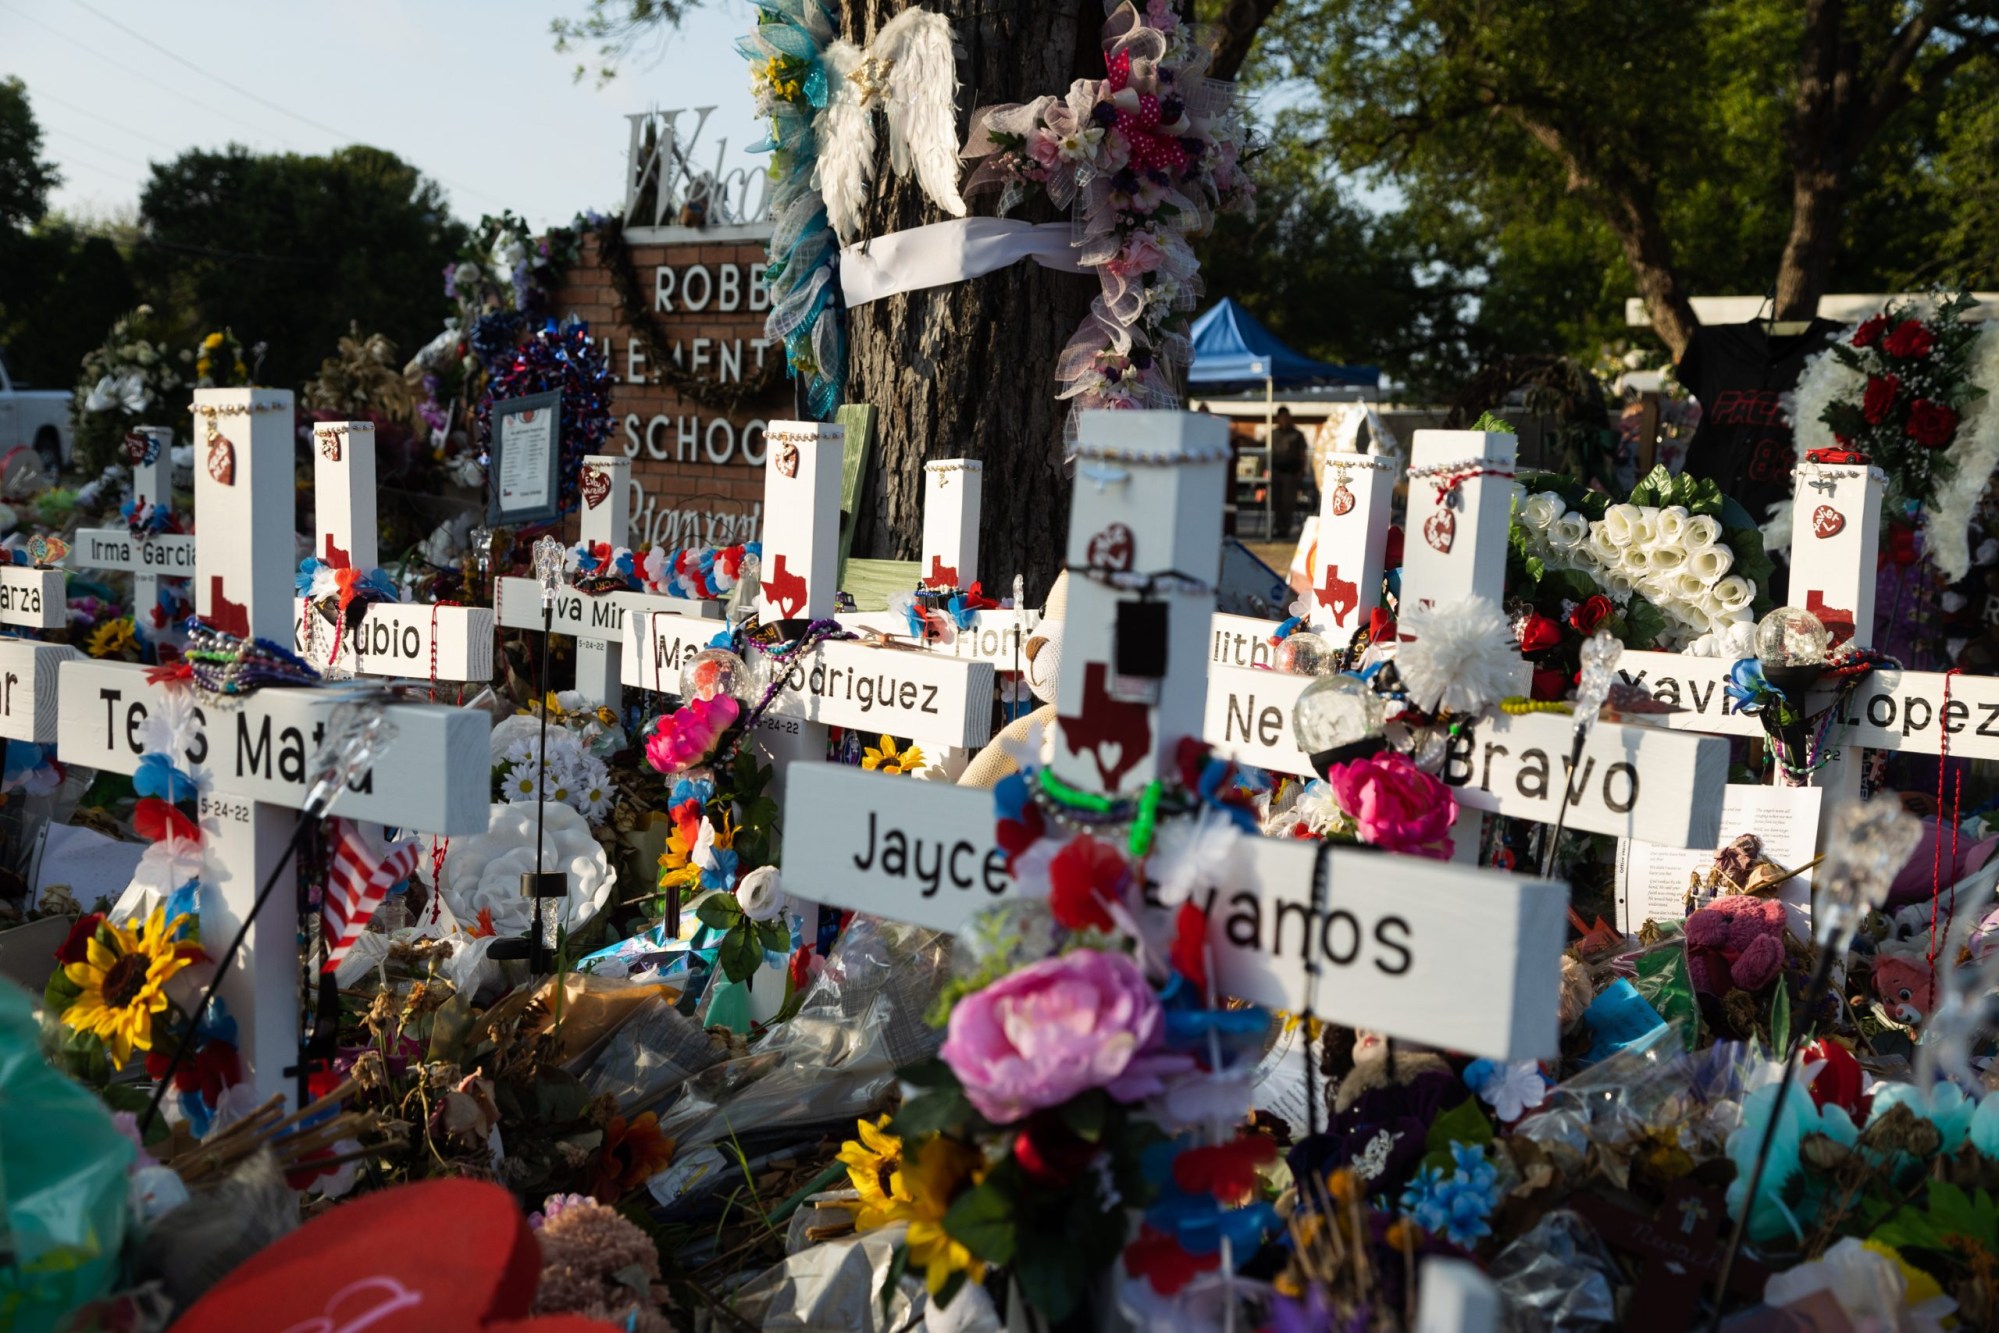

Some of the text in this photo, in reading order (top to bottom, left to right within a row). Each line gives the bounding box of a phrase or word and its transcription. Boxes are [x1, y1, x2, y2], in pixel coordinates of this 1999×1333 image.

[622, 104, 770, 232] Welco
[654, 263, 771, 313] ROBB
[91, 538, 131, 562] Irma
[0, 584, 41, 613] arza
[541, 596, 582, 622] va
[339, 616, 420, 659] ubio
[578, 639, 605, 651] 5-24-22
[1213, 630, 1275, 668] lith
[658, 634, 939, 715] Ma odriguez
[1617, 669, 1762, 718] avi
[100, 688, 374, 796] Tes Ma
[1224, 692, 1640, 814] Ne Bravo
[200, 797, 250, 823] 5-24-22
[853, 811, 1008, 898] Jayce
